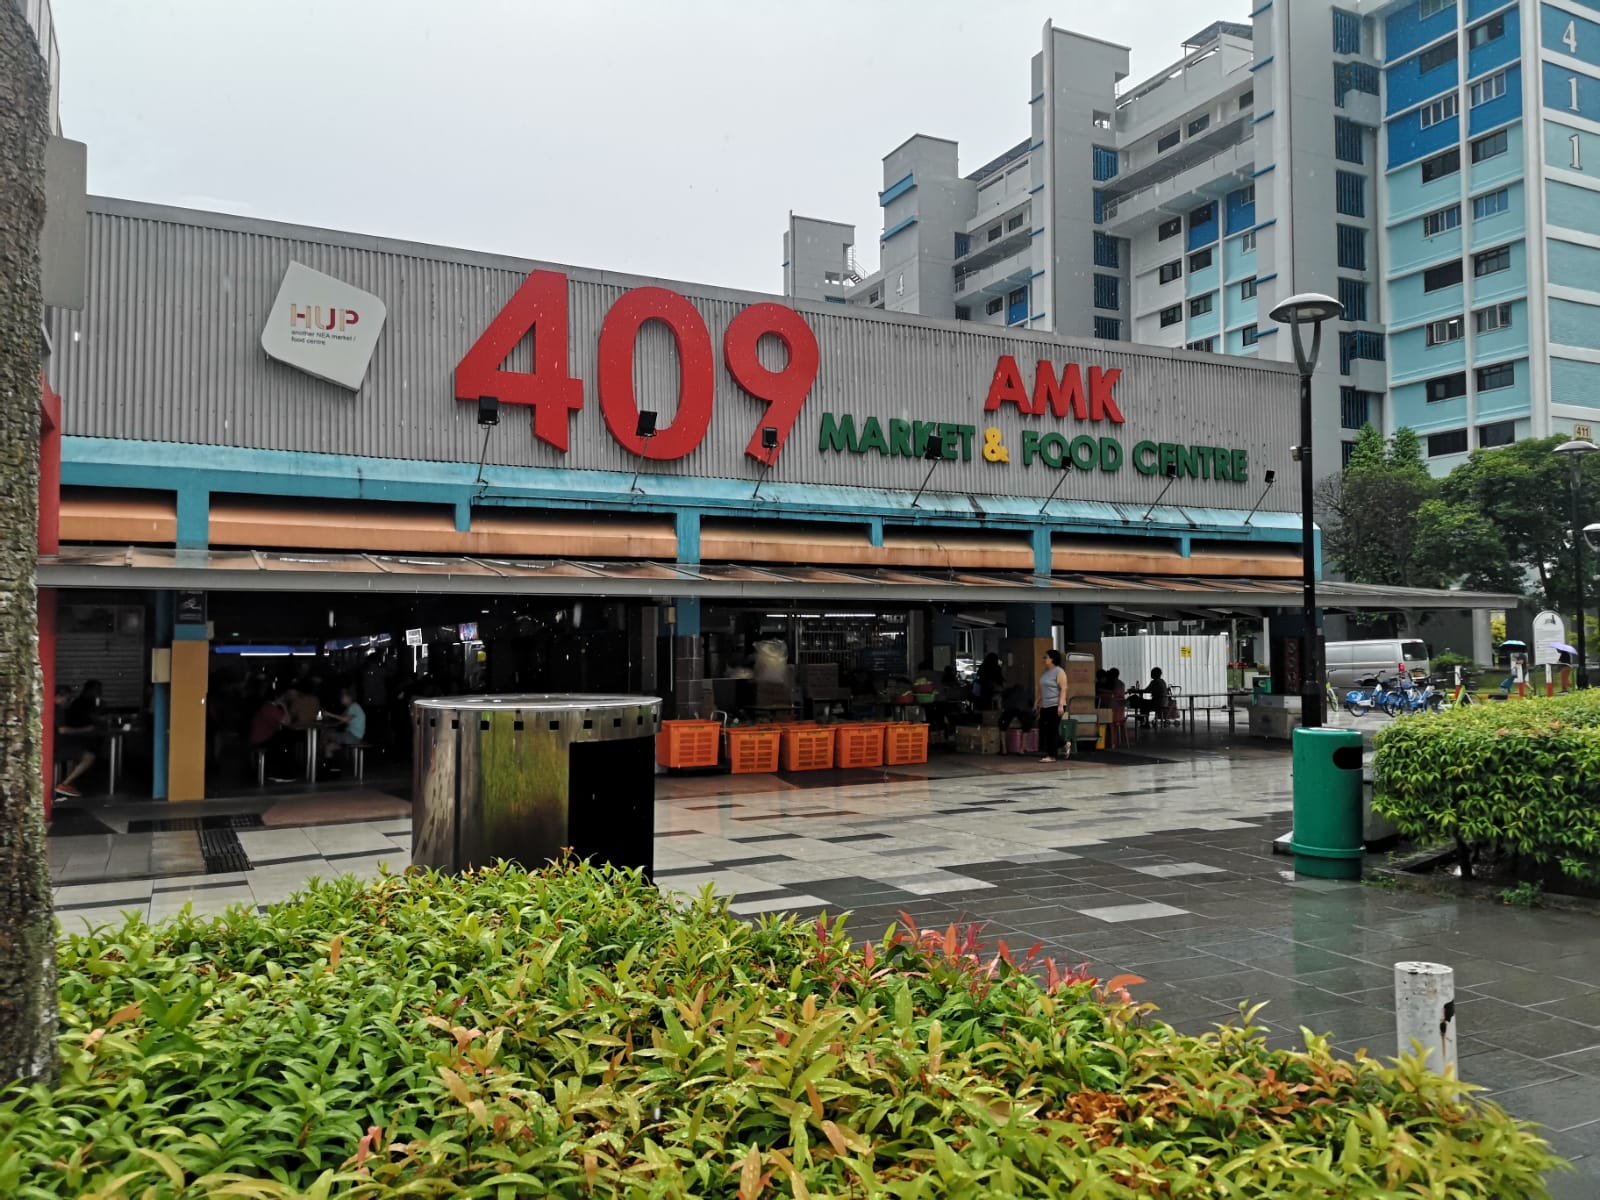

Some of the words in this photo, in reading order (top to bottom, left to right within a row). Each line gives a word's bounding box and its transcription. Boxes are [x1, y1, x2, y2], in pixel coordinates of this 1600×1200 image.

[290, 303, 360, 332] HUP
[455, 268, 820, 468] 409
[984, 355, 1125, 424] AMK
[819, 412, 976, 461] MARKET
[982, 427, 1010, 463] &
[1022, 429, 1124, 472] FOOD
[1133, 440, 1248, 482] CENTRE
[1576, 426, 1590, 437] 411
